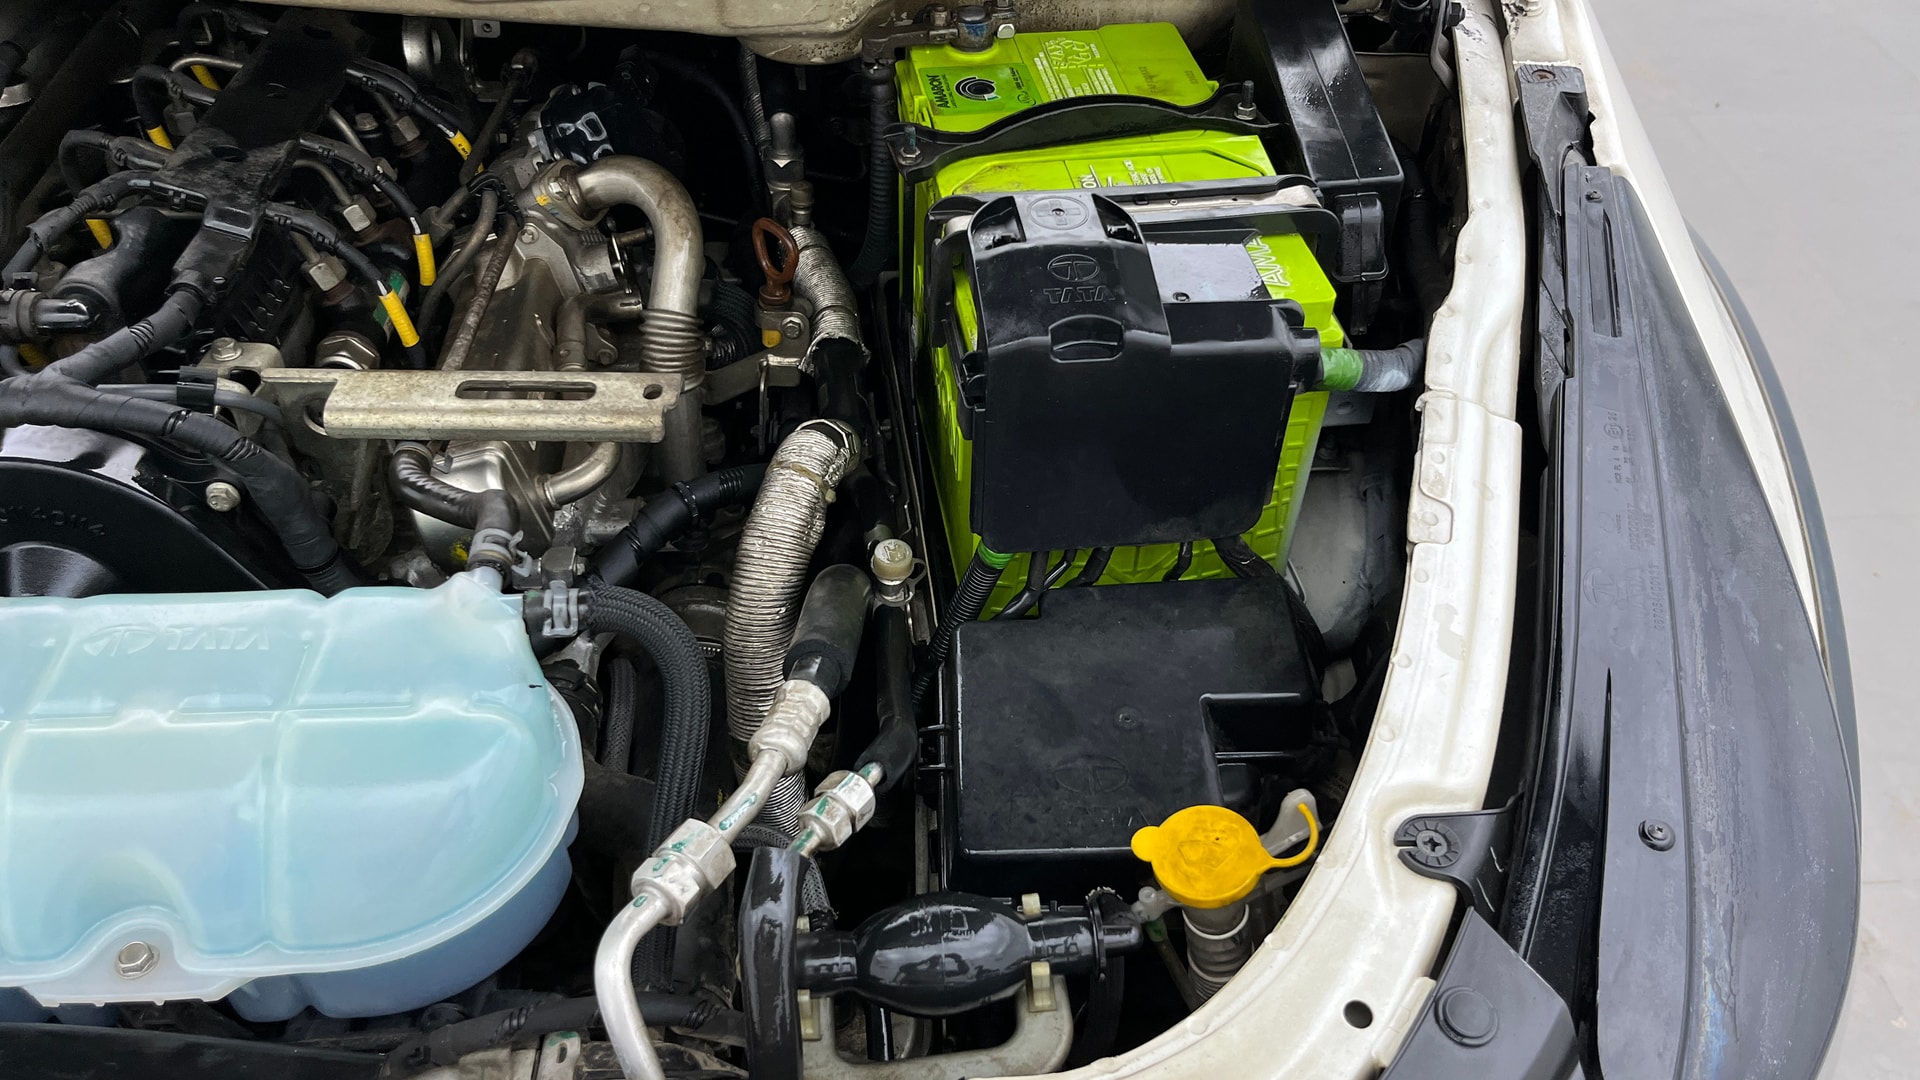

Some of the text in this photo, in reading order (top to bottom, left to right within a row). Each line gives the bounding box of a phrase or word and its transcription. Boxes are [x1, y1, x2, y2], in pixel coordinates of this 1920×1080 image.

[926, 74, 951, 108] AMARON
[1043, 285, 1117, 304] TATA
[166, 624, 271, 650] TATA
